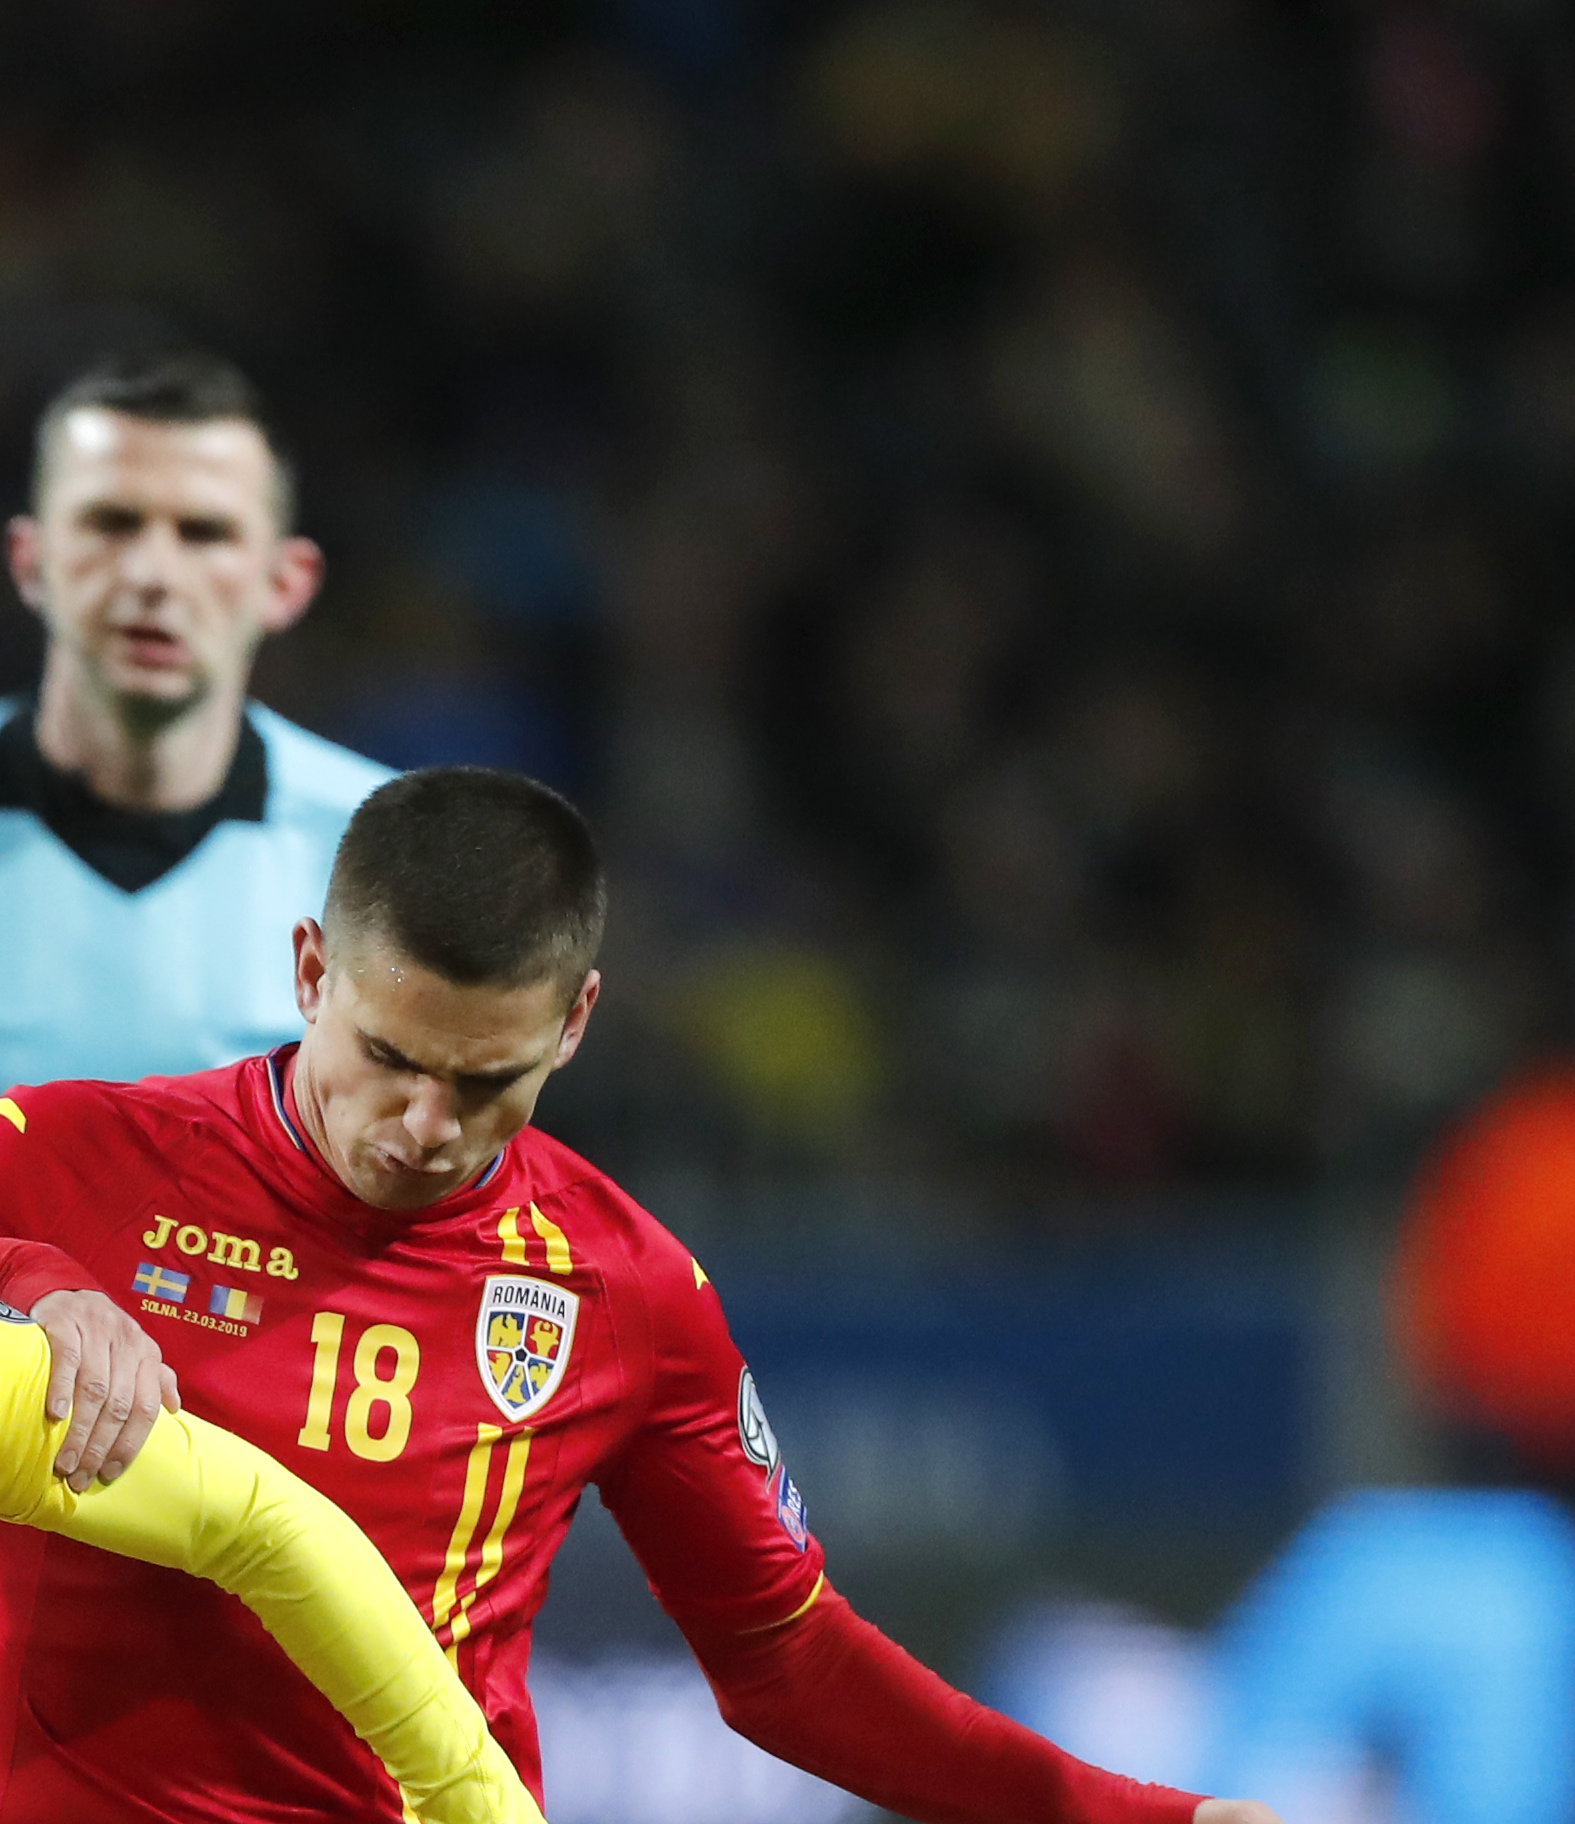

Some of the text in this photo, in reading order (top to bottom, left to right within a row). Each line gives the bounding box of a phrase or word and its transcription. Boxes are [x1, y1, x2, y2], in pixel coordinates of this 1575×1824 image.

[142, 1214, 299, 1281] Joma
[140, 1299, 248, 1337] SOLNA, 23.03.2019
[492, 1285, 565, 1318] ROMÂNIA
[297, 1311, 421, 1463] 18
